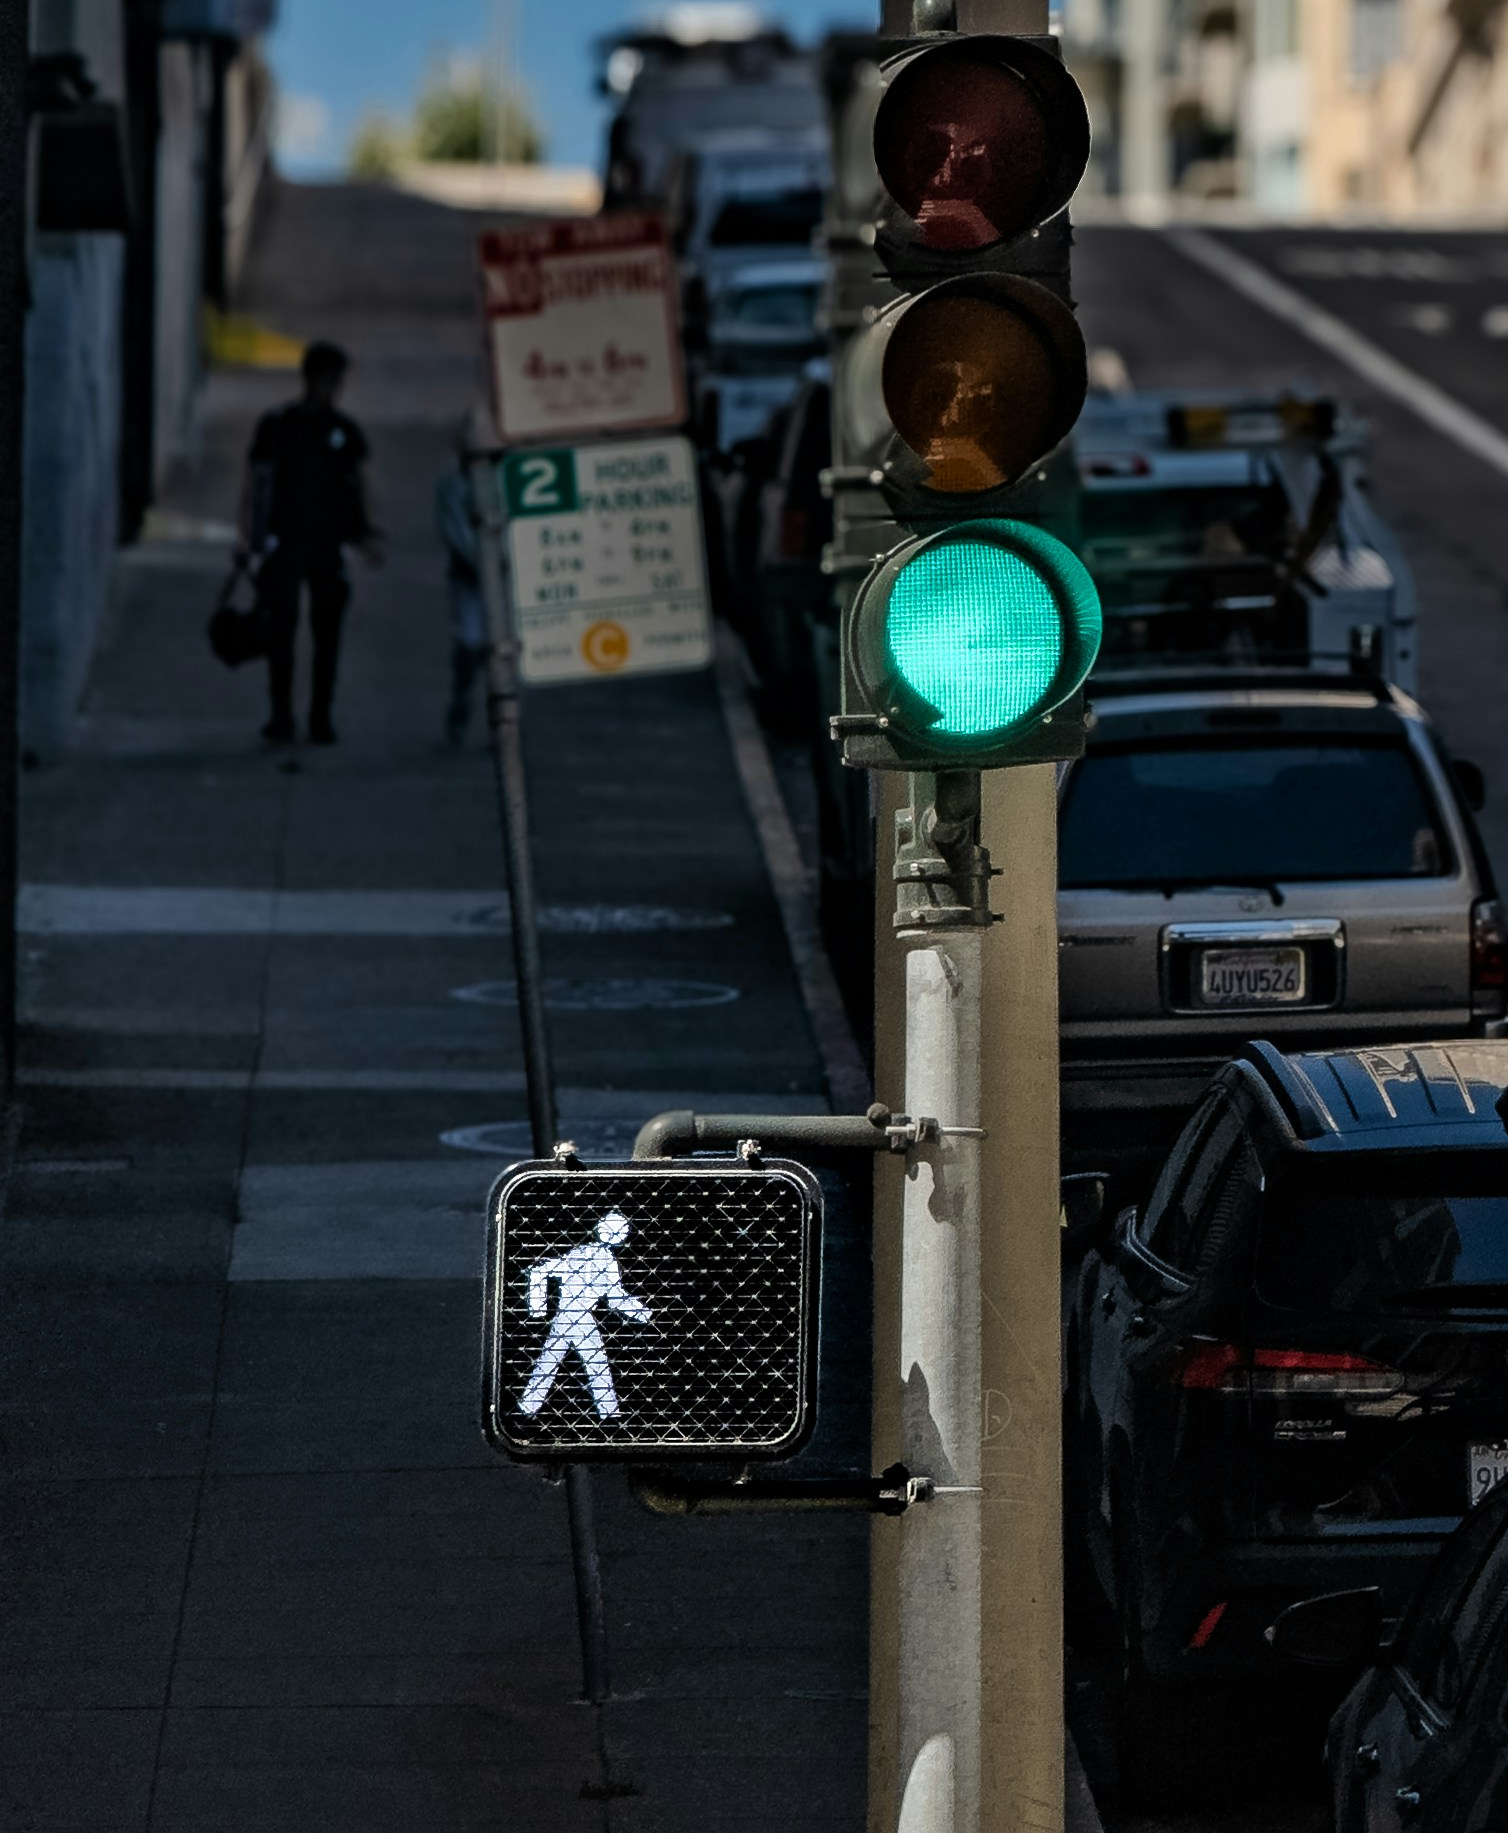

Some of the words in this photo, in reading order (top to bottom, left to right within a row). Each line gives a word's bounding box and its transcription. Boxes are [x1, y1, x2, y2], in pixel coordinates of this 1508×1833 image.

[518, 457, 561, 508] 2
[596, 452, 670, 481] HOUR
[579, 484, 698, 513] PARKING
[589, 626, 628, 666] C
[1210, 968, 1296, 994] 4UYU526
